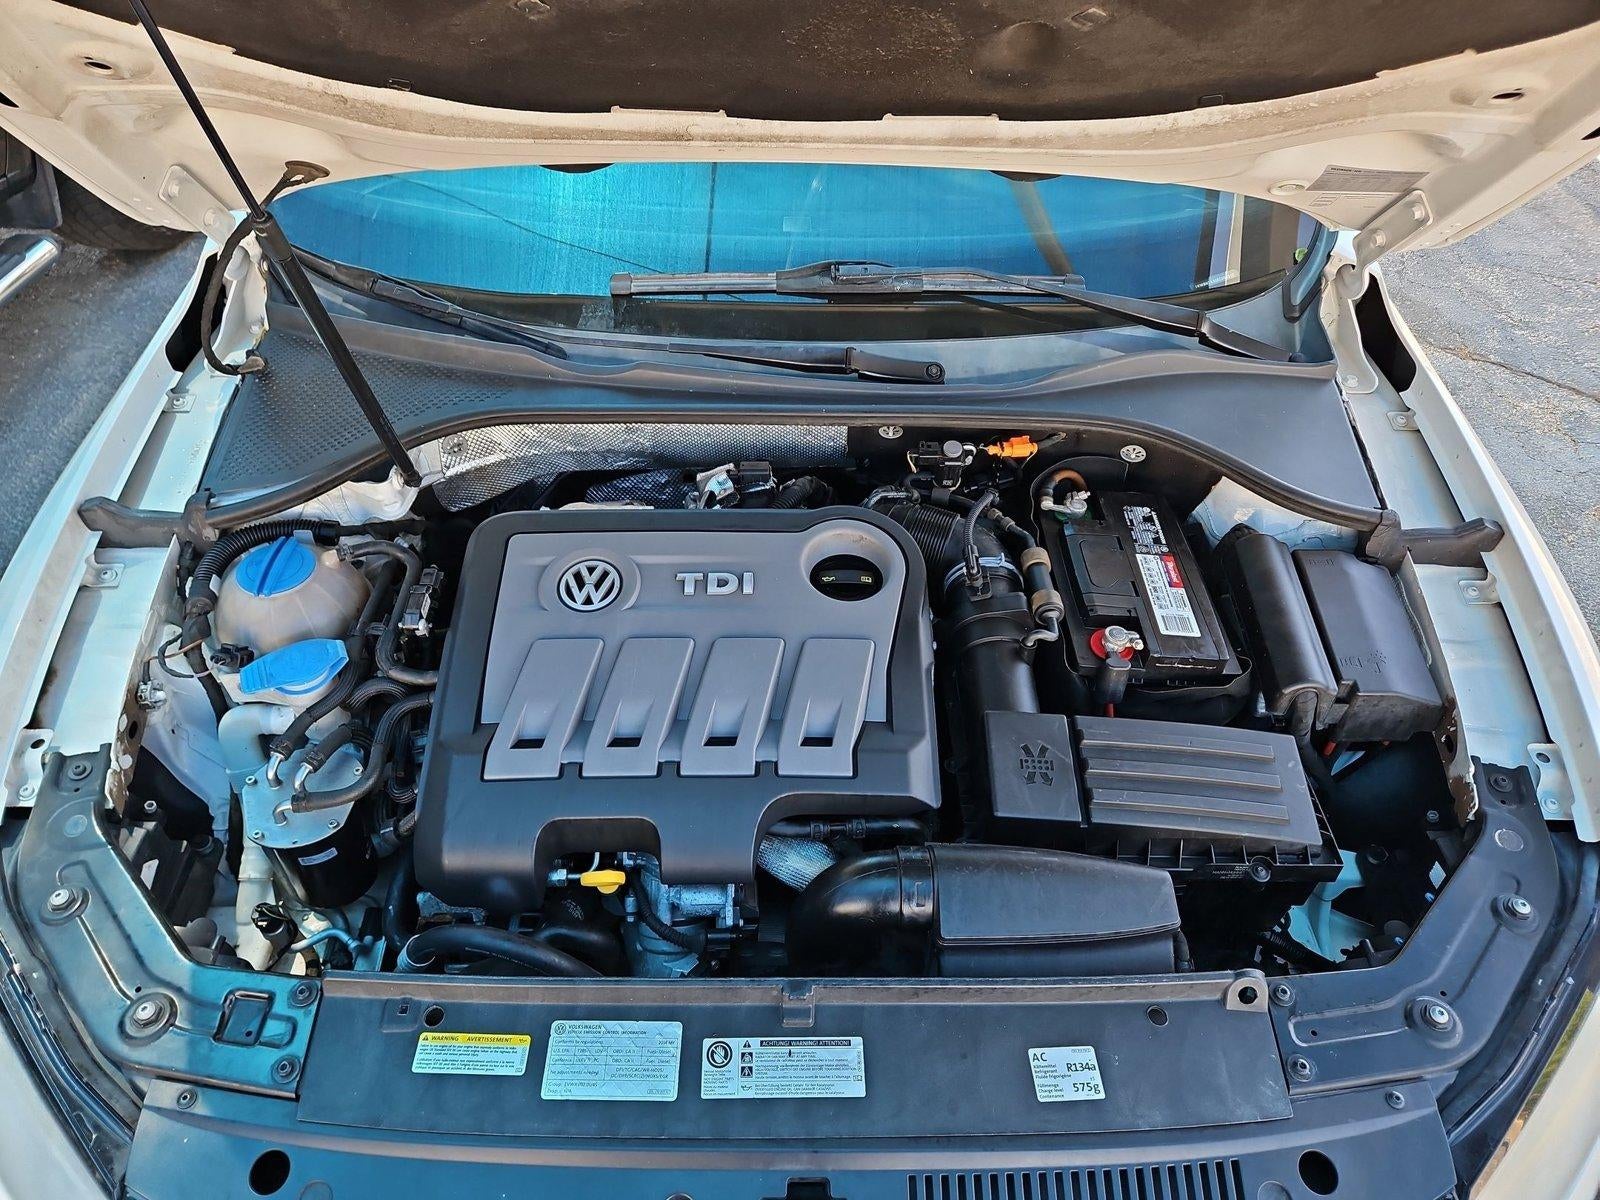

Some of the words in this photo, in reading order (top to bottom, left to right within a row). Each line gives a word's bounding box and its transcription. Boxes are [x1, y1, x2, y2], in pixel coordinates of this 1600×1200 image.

[676, 572, 755, 595] TDI
[1032, 1052, 1048, 1062] AC
[1066, 1062, 1097, 1072] R134a
[1072, 1082, 1101, 1095] 575g
